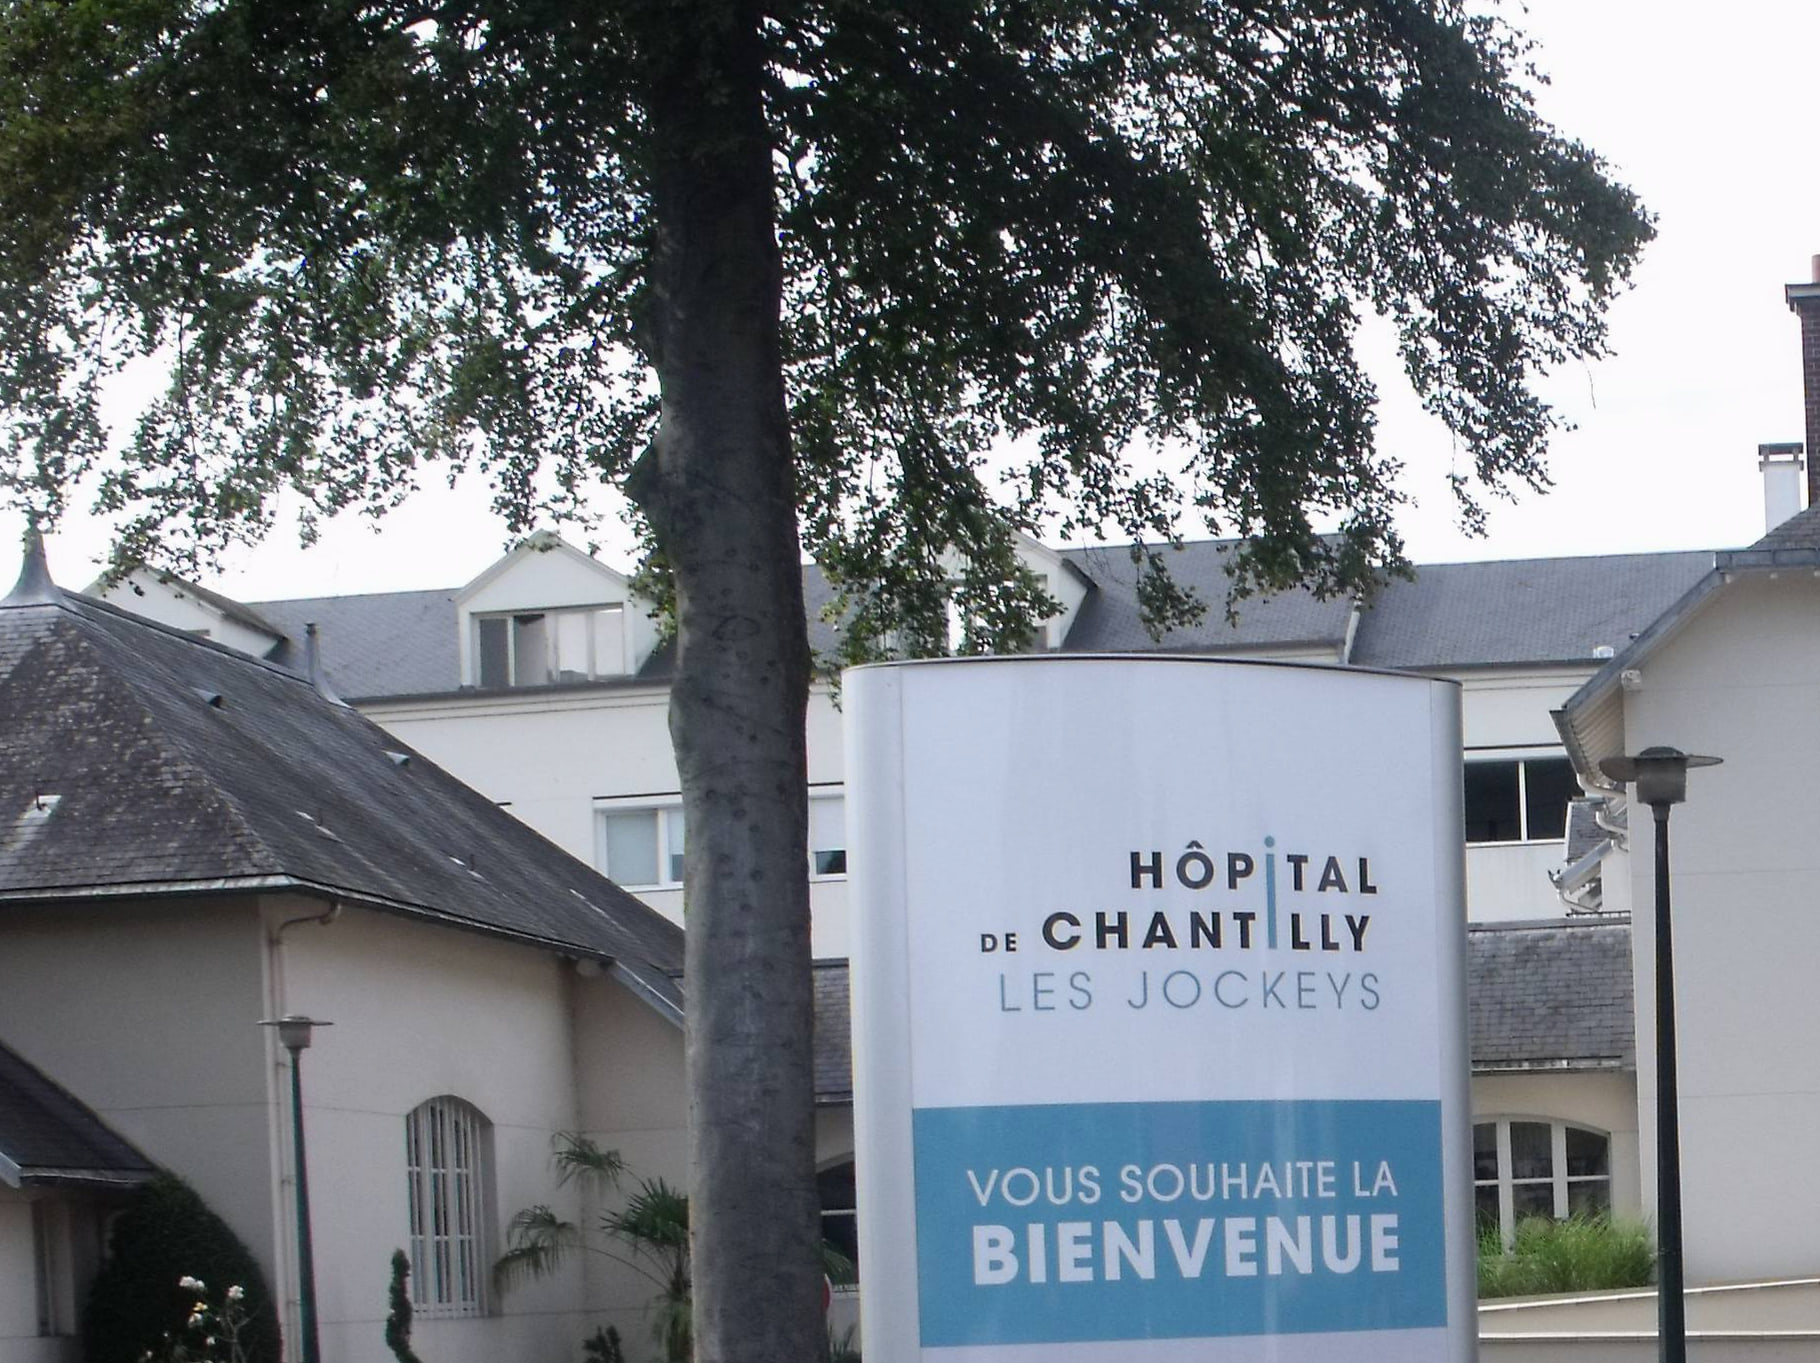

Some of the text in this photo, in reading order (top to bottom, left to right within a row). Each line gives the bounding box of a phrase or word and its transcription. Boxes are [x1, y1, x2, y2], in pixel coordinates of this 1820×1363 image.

[980, 932, 1018, 954] DE
[1000, 970, 1381, 1012] LES JOCKEYS
[968, 1161, 1399, 1207] VOUS SOUHAITE LA
[972, 1214, 1400, 1286] BIENVENUE
